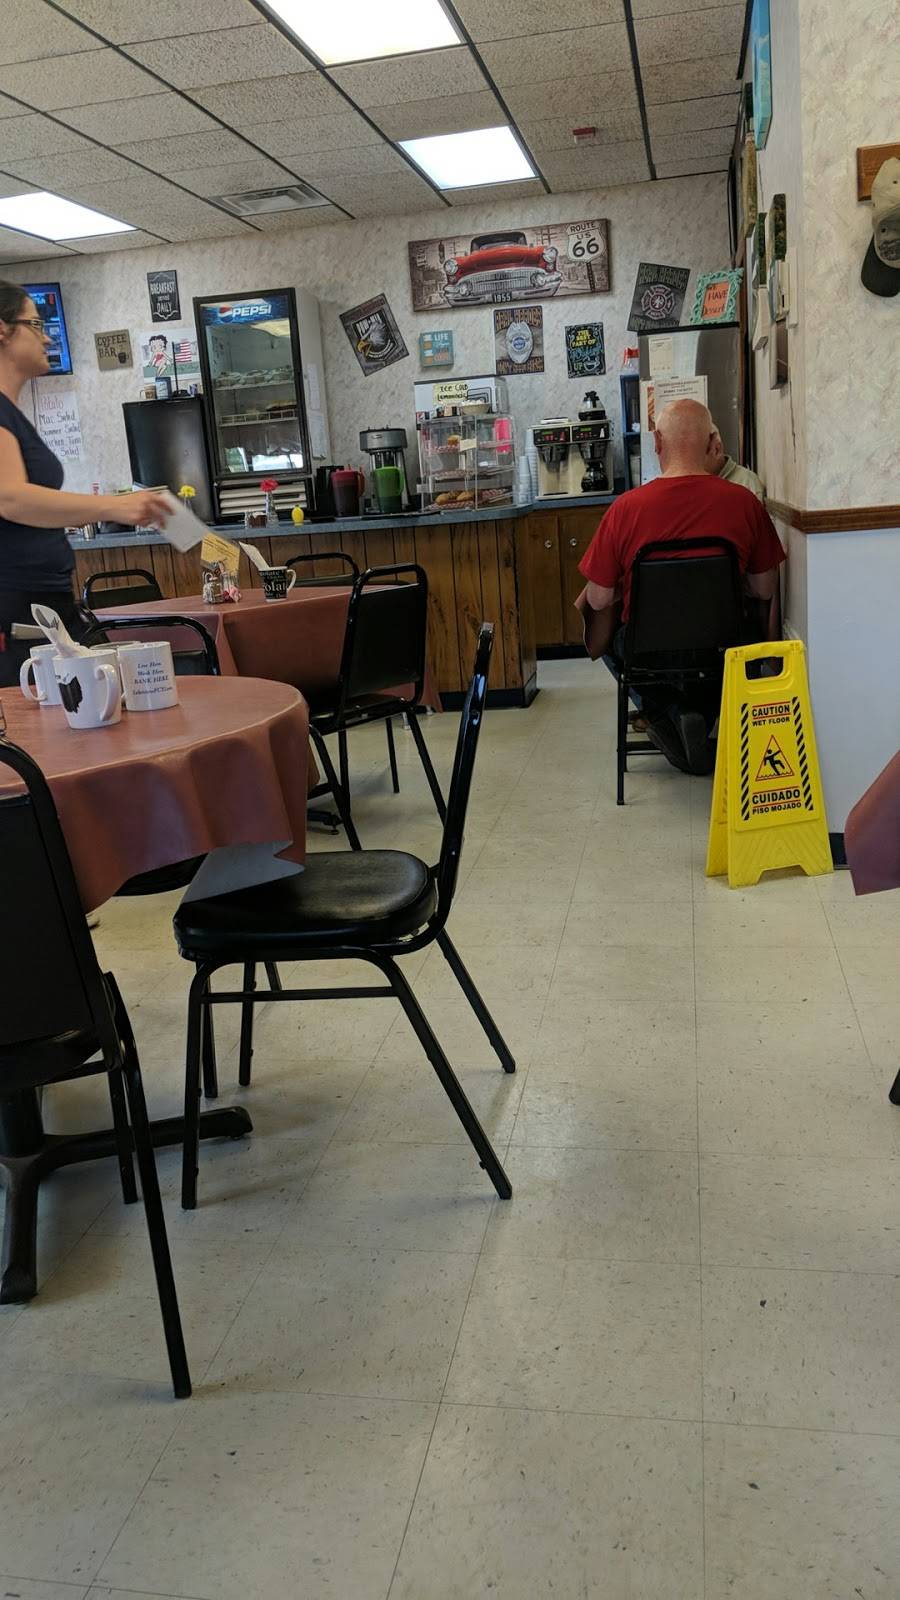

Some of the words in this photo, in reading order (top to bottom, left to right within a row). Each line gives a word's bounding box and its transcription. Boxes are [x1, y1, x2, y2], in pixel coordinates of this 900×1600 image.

[570, 223, 596, 232] ROUTE
[572, 238, 600, 258] 66
[150, 281, 176, 295] BREAKFAST
[493, 292, 512, 303] 1955
[708, 289, 728, 300] HAVE
[157, 302, 172, 313] DAILY
[232, 305, 271, 317] PEPSI
[97, 334, 127, 347] COFFEE
[434, 333, 449, 341] LIFE
[99, 346, 117, 358] BAR
[752, 704, 790, 717] CAUTION
[768, 717, 790, 725] FLOOR
[752, 789, 801, 805] CUIDADO
[752, 805, 770, 815] PISO
[771, 802, 802, 812] MOJADO
